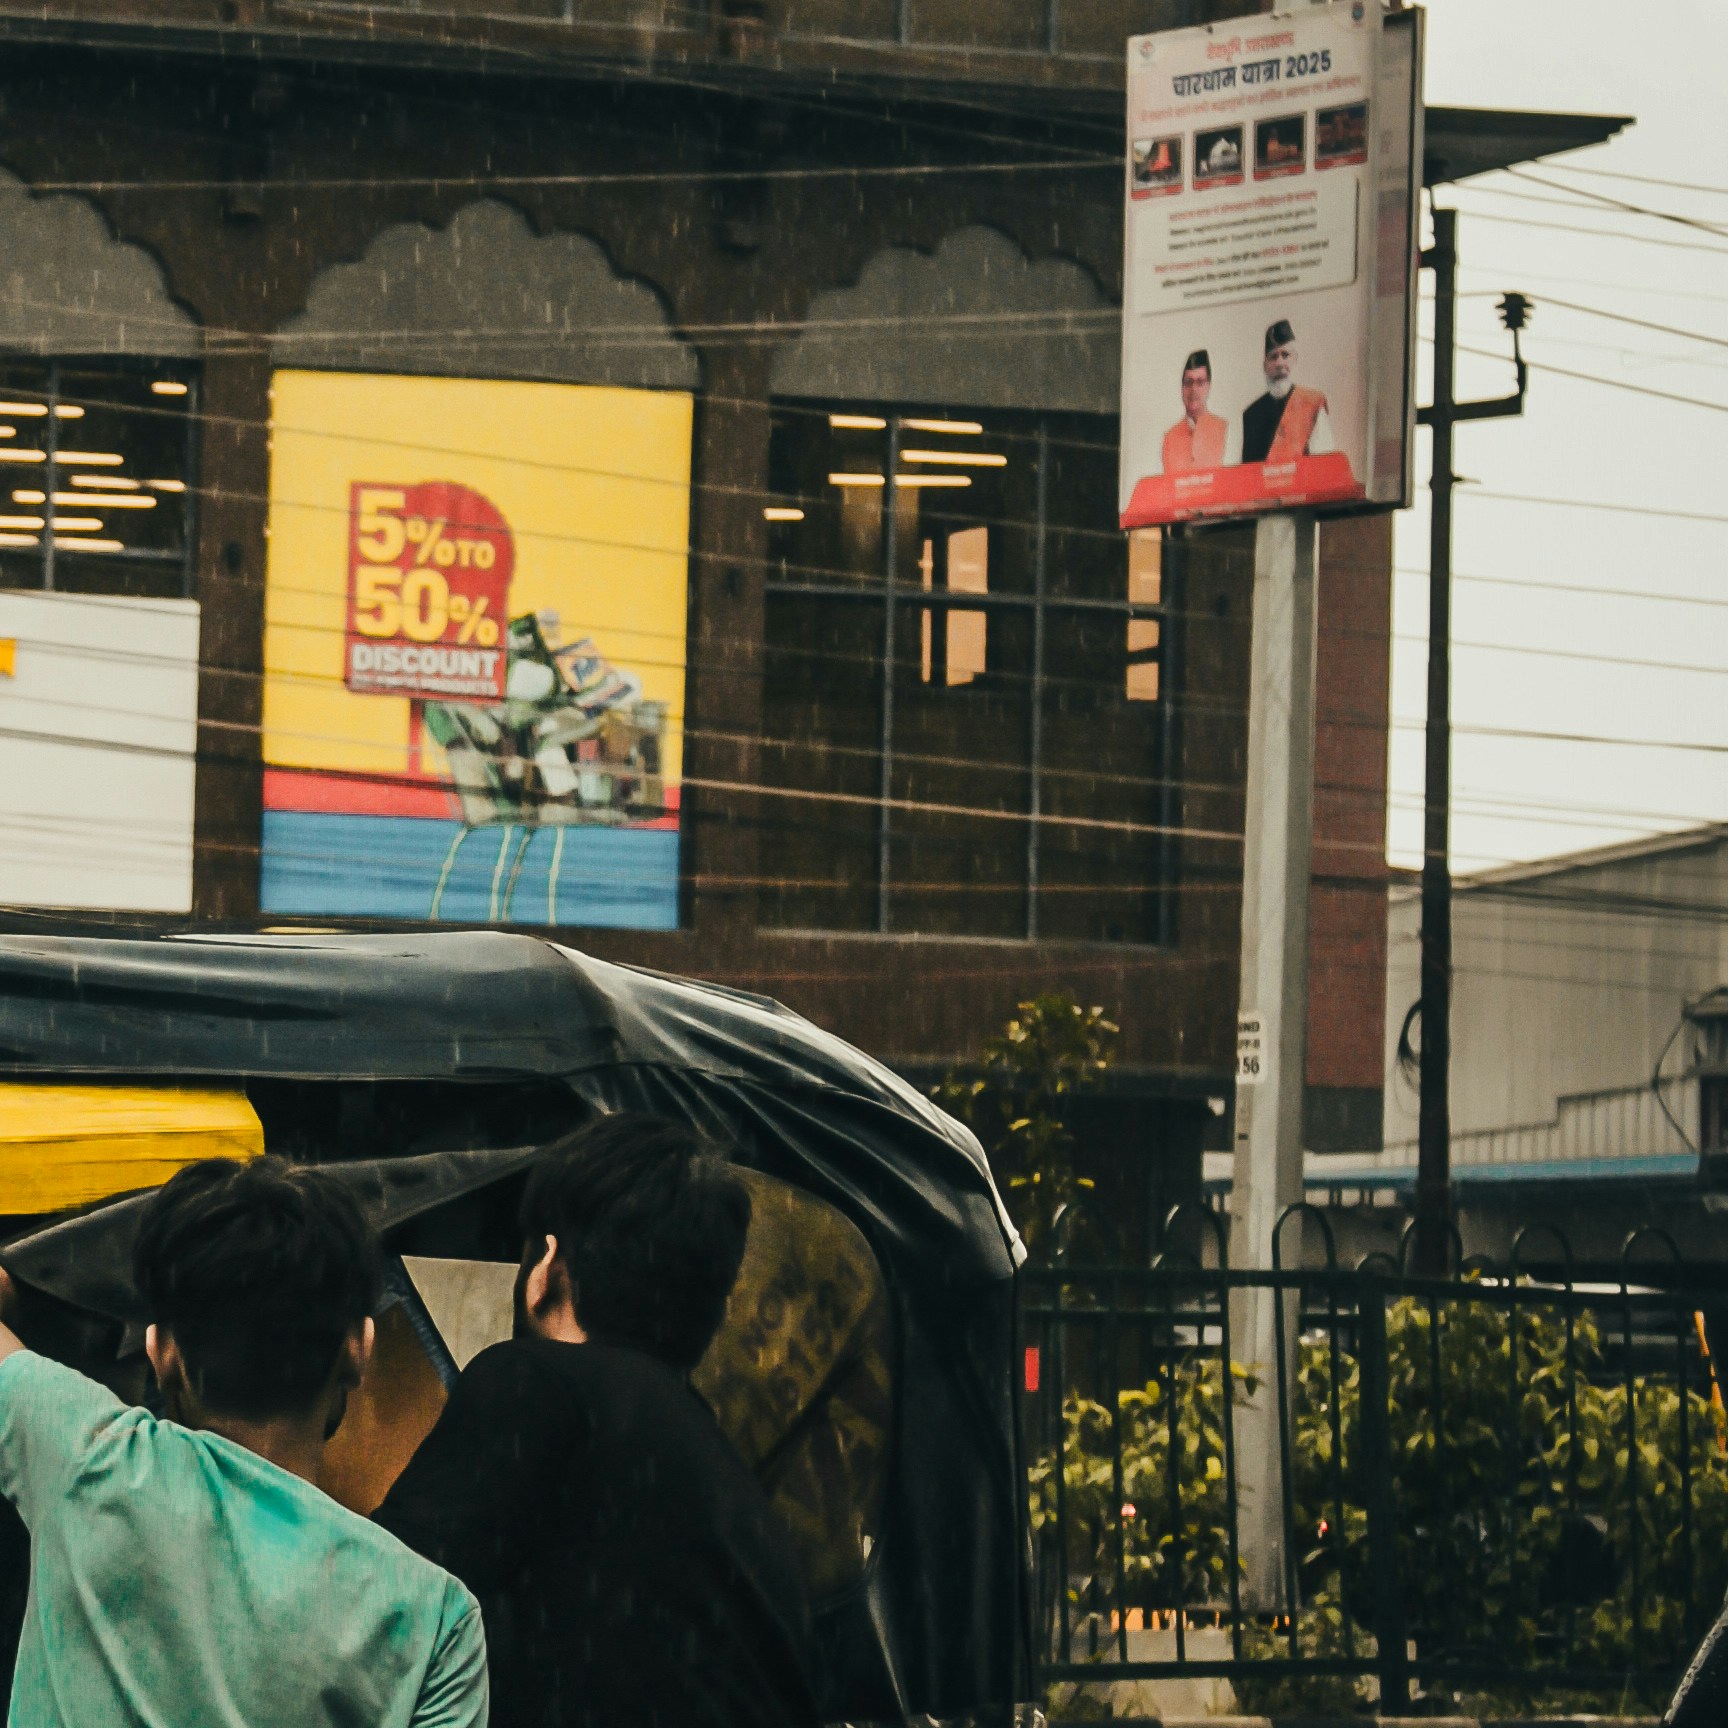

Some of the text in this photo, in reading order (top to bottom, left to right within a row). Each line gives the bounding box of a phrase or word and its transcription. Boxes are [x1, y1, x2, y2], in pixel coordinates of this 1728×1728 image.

[1172, 49, 1332, 97] चारधाम यात्रा 2025
[355, 566, 499, 647] 50%
[352, 643, 499, 678] DISCOUNT
